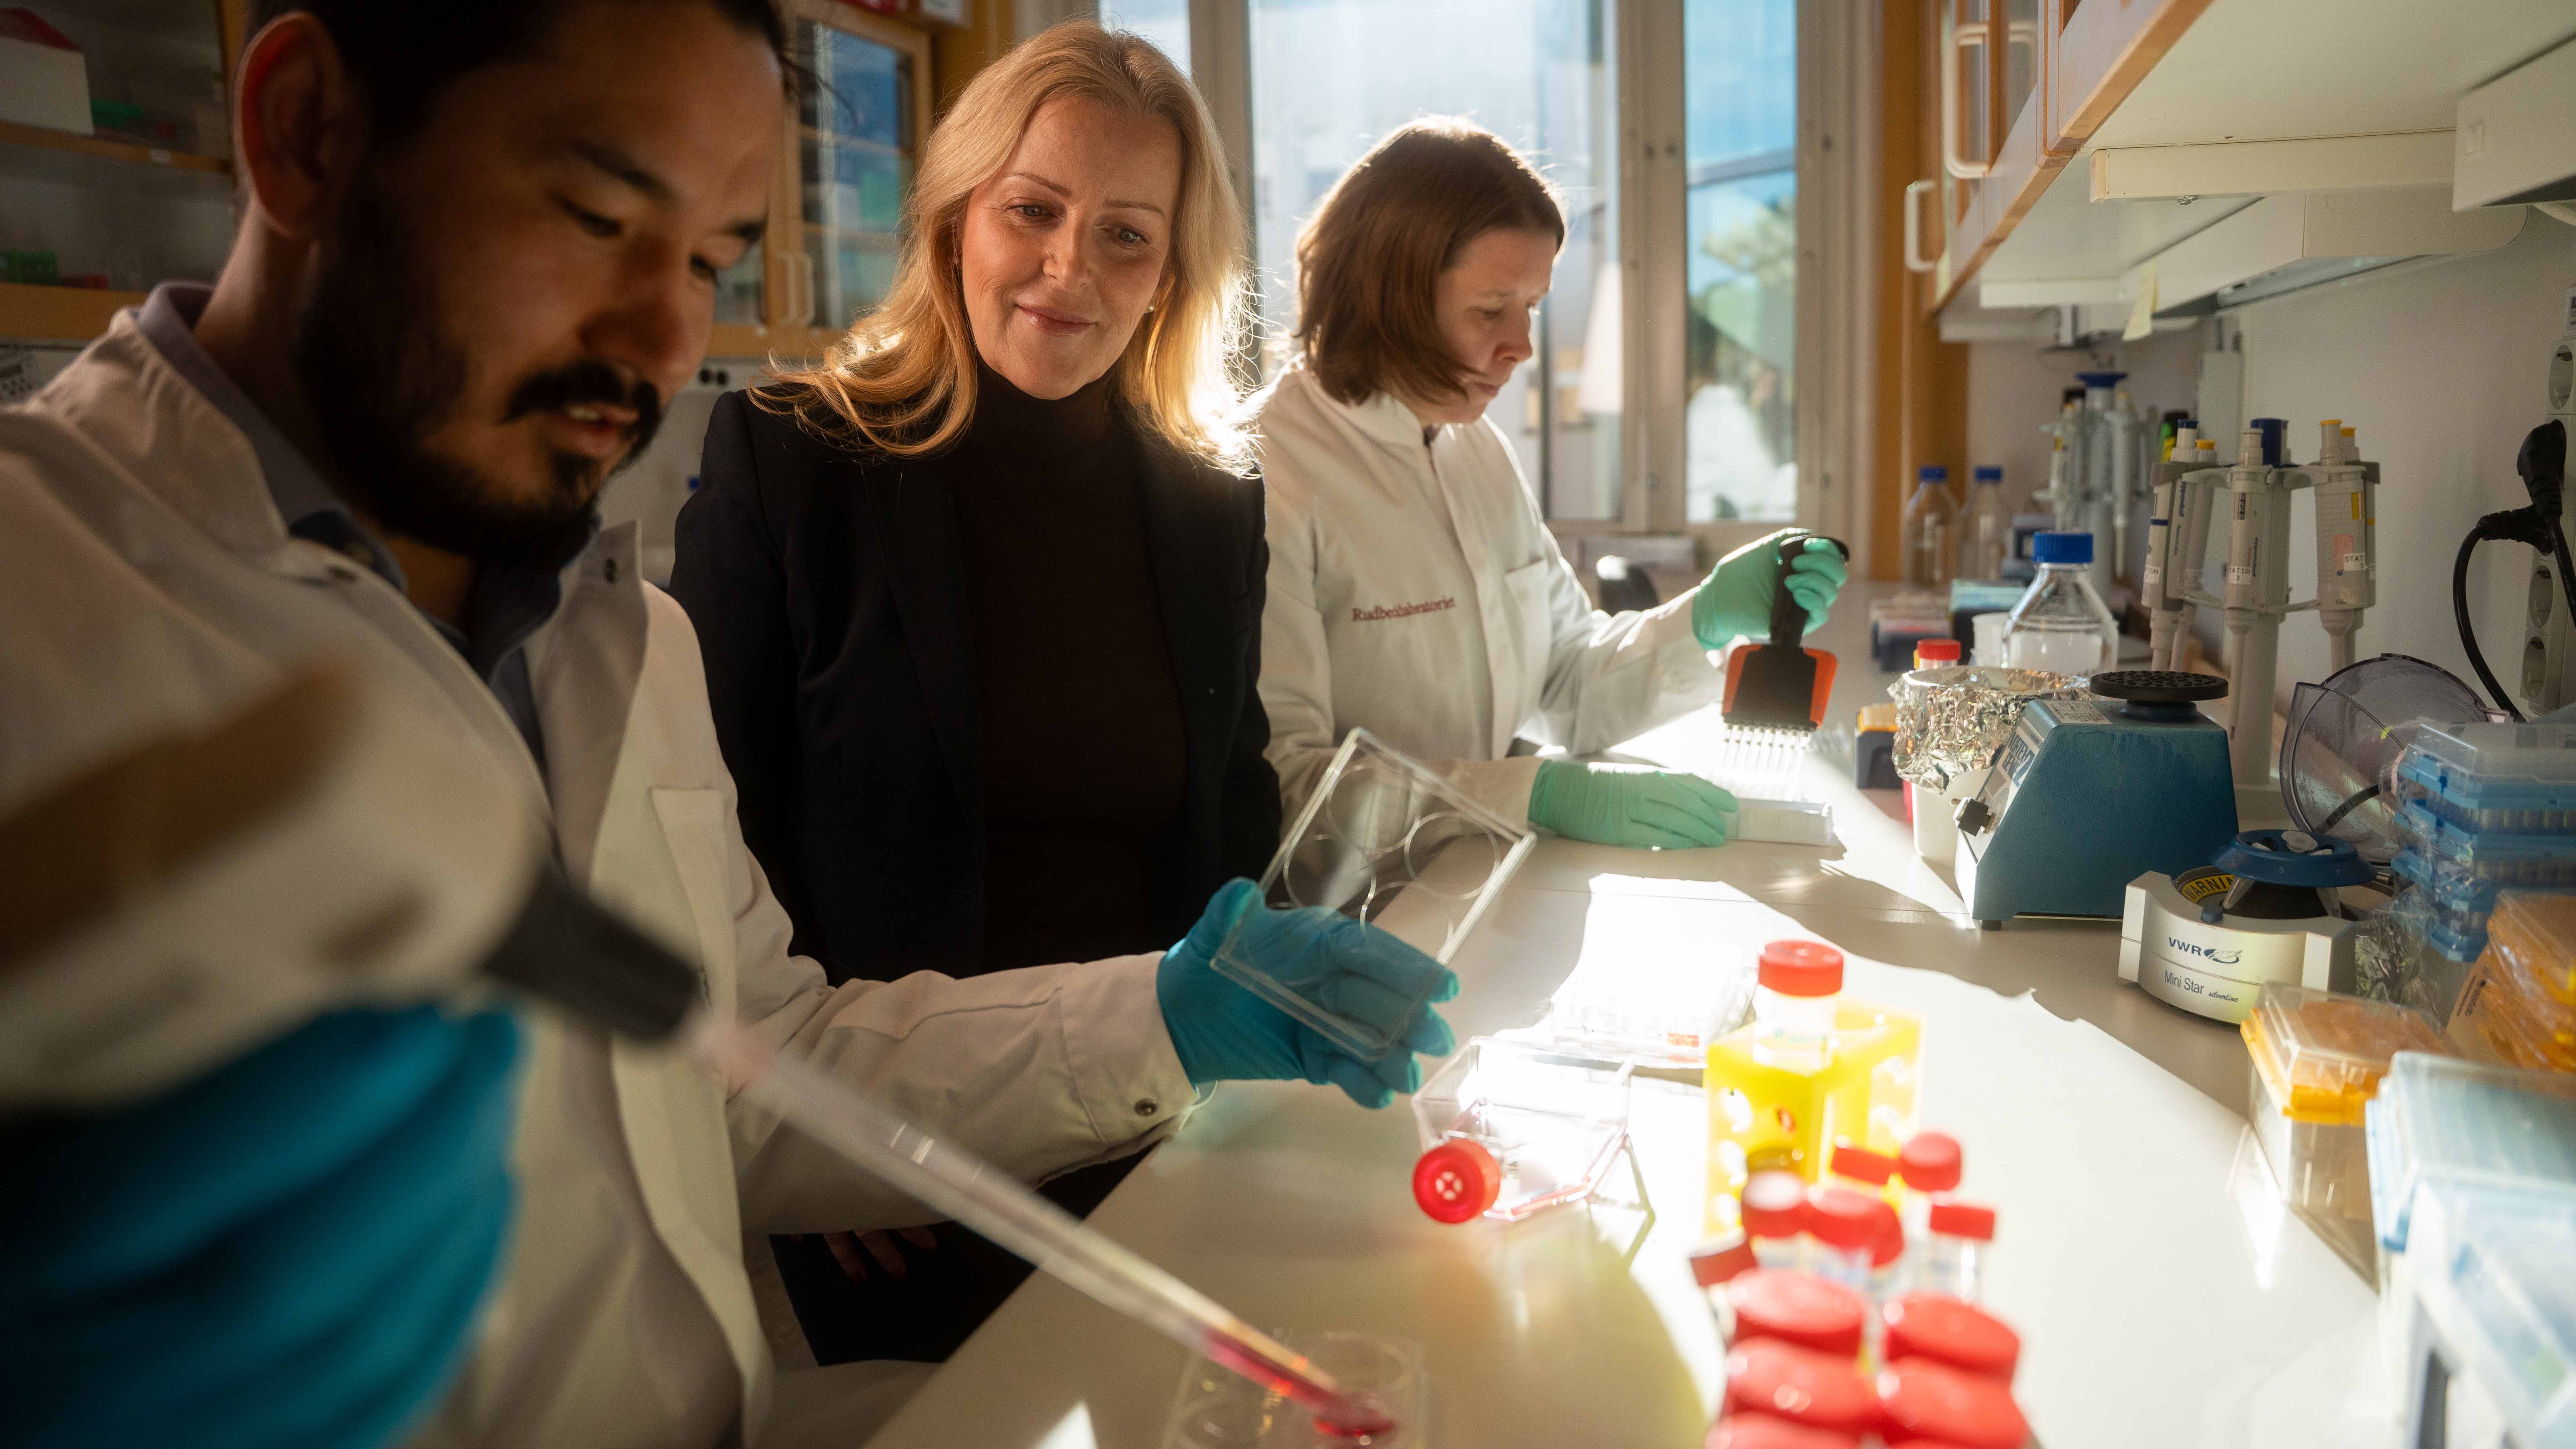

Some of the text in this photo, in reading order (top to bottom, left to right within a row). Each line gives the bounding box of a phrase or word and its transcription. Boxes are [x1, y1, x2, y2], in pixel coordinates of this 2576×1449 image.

[2168, 937, 2201, 956] VWR
[2164, 970, 2239, 1002] Mini Star silverline
